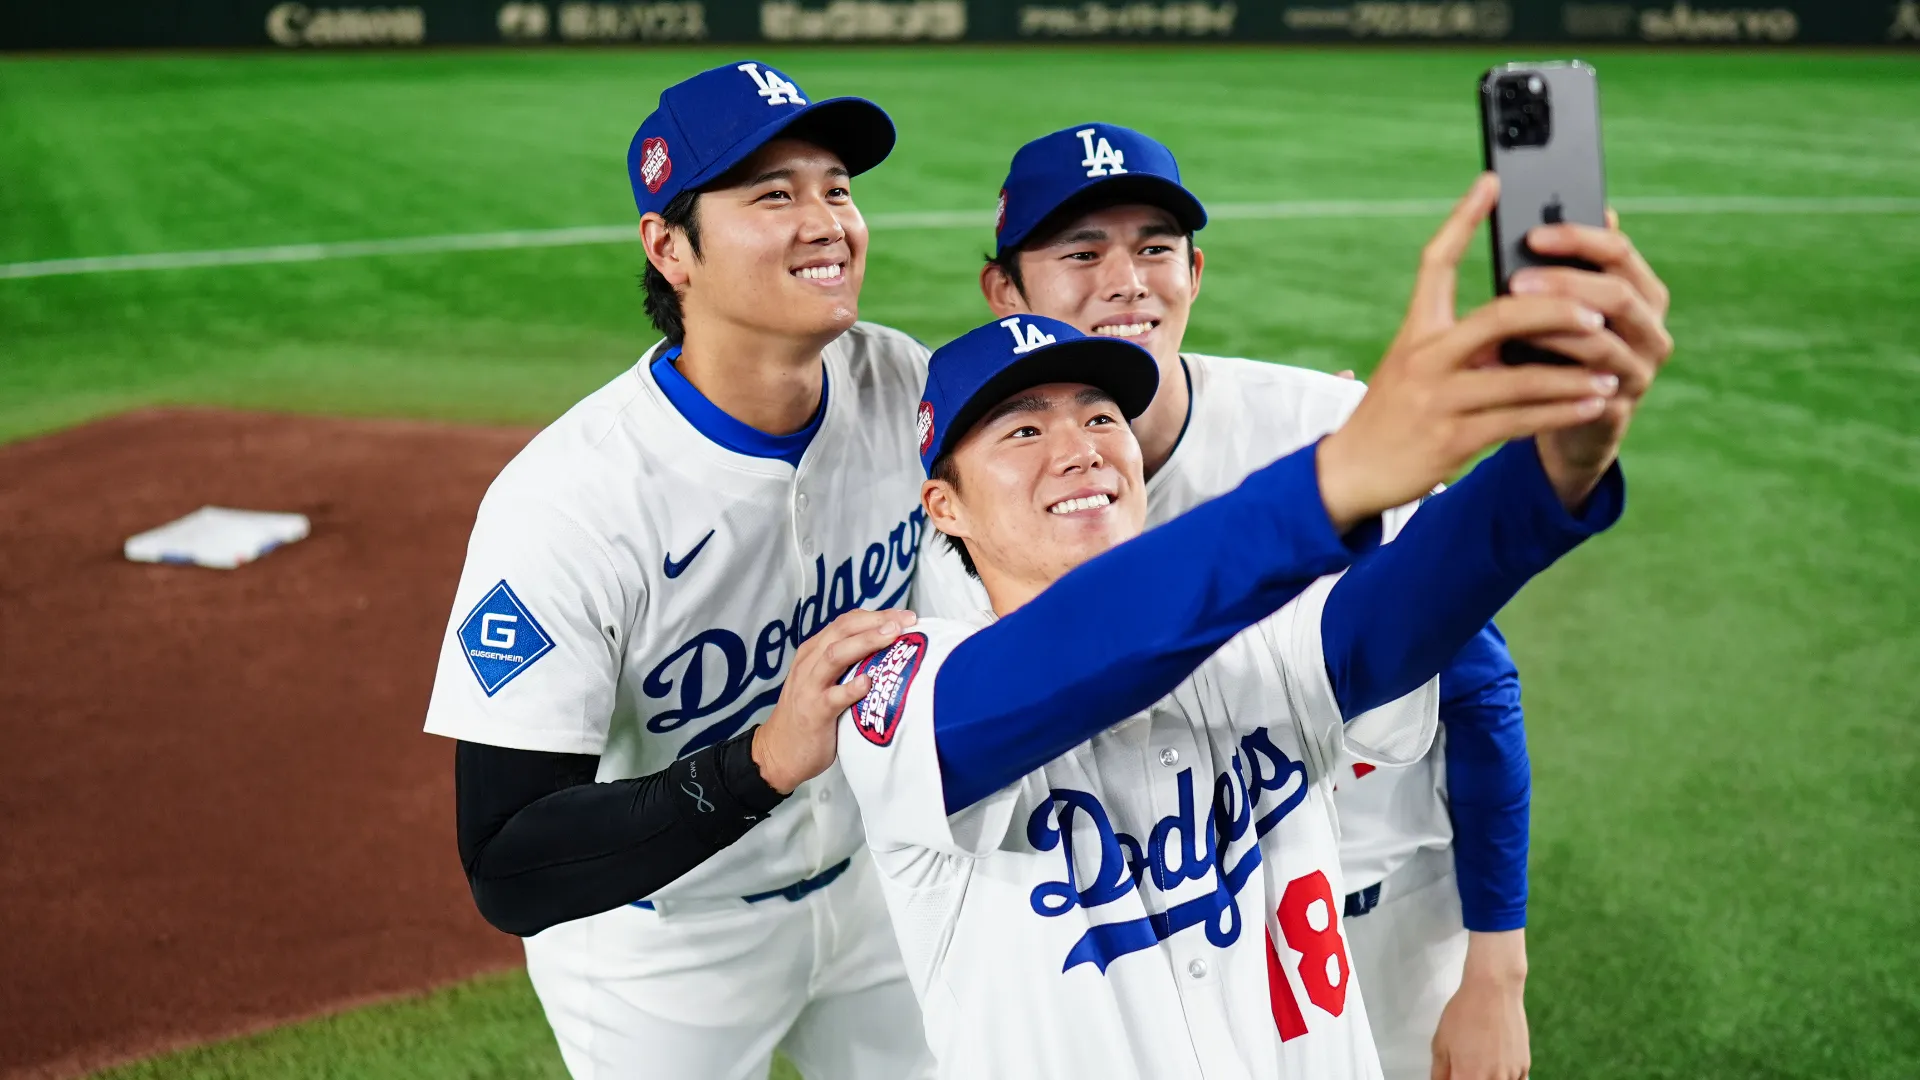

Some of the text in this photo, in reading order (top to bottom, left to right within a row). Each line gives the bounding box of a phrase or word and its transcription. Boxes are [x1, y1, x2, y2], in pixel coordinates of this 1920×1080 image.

[738, 63, 807, 106] LA
[1076, 128, 1128, 178] LA
[1000, 317, 1057, 354] LA
[480, 612, 518, 649] G
[470, 649, 524, 663] GUGGENHEIM
[865, 643, 909, 727] TOKYO
[874, 645, 919, 736] SERIES
[1264, 868, 1350, 1043] 18
